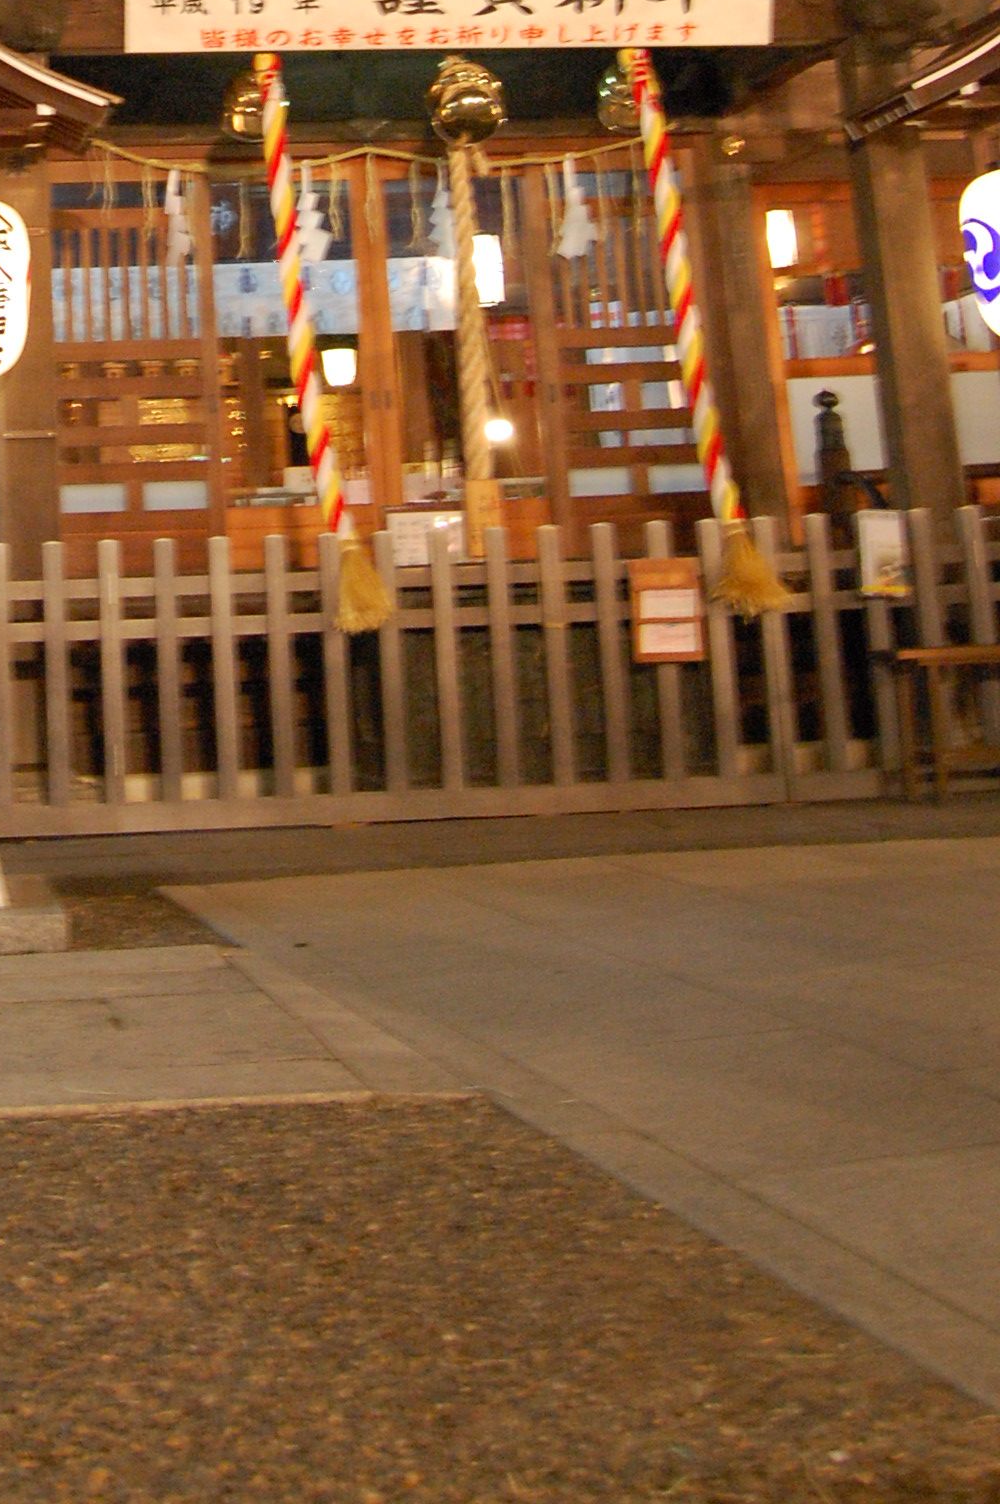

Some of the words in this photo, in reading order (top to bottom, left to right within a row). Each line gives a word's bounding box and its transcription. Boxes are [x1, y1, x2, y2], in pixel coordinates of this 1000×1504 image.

[200, 23, 698, 48] 皆様のお幸せをお祈り申し上げます
